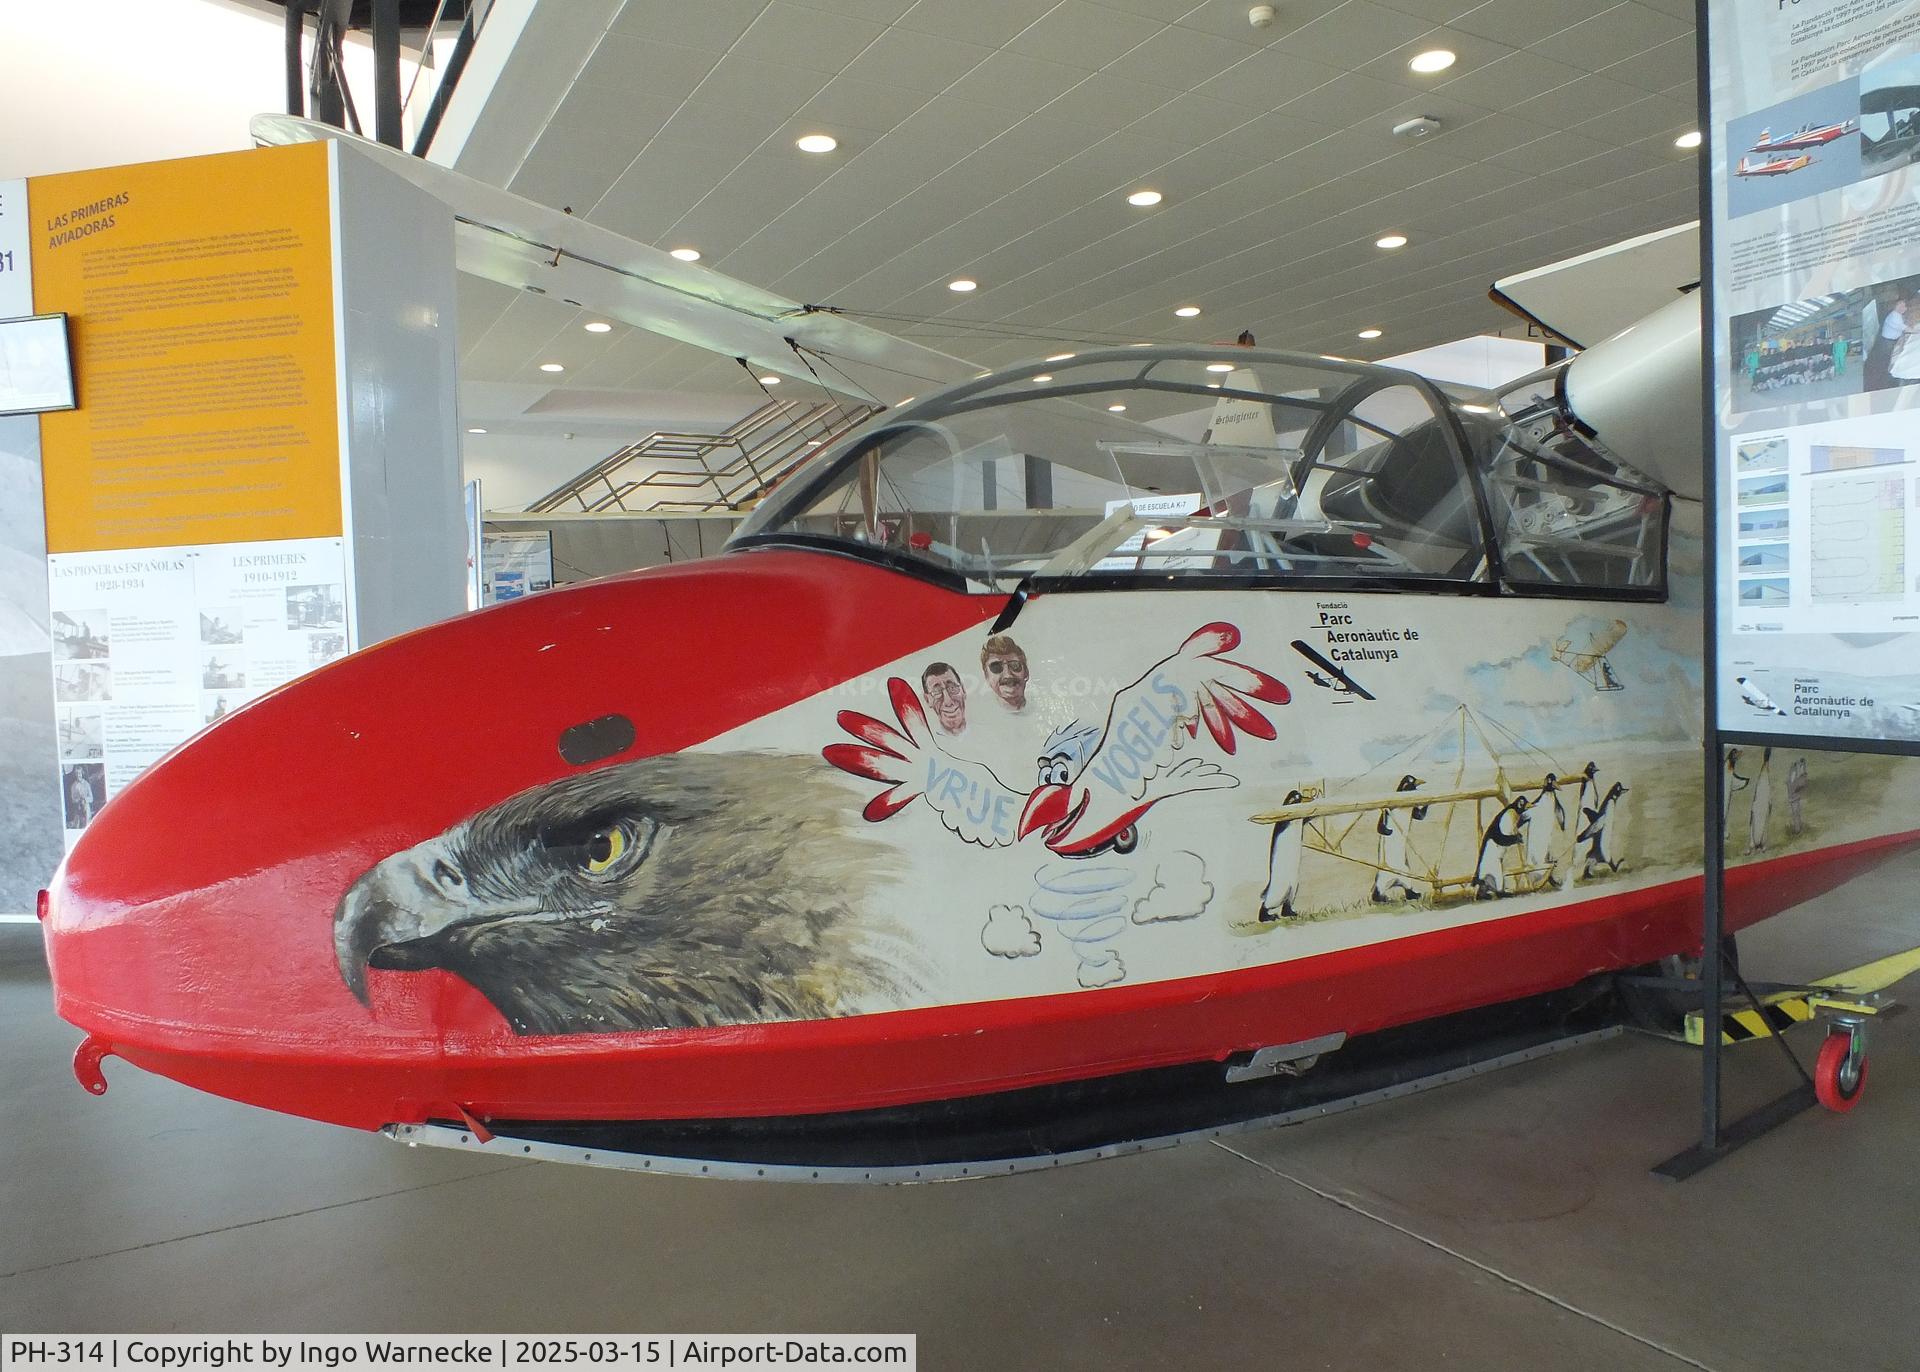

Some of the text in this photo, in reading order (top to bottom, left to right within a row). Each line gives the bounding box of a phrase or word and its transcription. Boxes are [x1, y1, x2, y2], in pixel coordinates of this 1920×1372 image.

[47, 191, 130, 232] LAS PRIMERAS
[48, 215, 116, 250] AVIADORAS
[1139, 504, 1147, 512] DE
[1147, 502, 1175, 511] ESCUELA
[233, 552, 307, 567] LES PRIMERES
[55, 559, 185, 577] LAS PIONERAS ESPAÑOLAS
[243, 570, 298, 583] 1910-1912
[95, 579, 145, 591] 1928-1934
[1320, 612, 1353, 625] Parc
[1328, 628, 1419, 643] Aeronàutic de
[1331, 648, 1399, 662] Catalunya
[1794, 684, 1819, 694] Parc
[1794, 695, 1874, 706] Aeronàutic de
[1794, 706, 1850, 719] Catalunya
[926, 673, 1188, 837] VRIJE VOGELS
